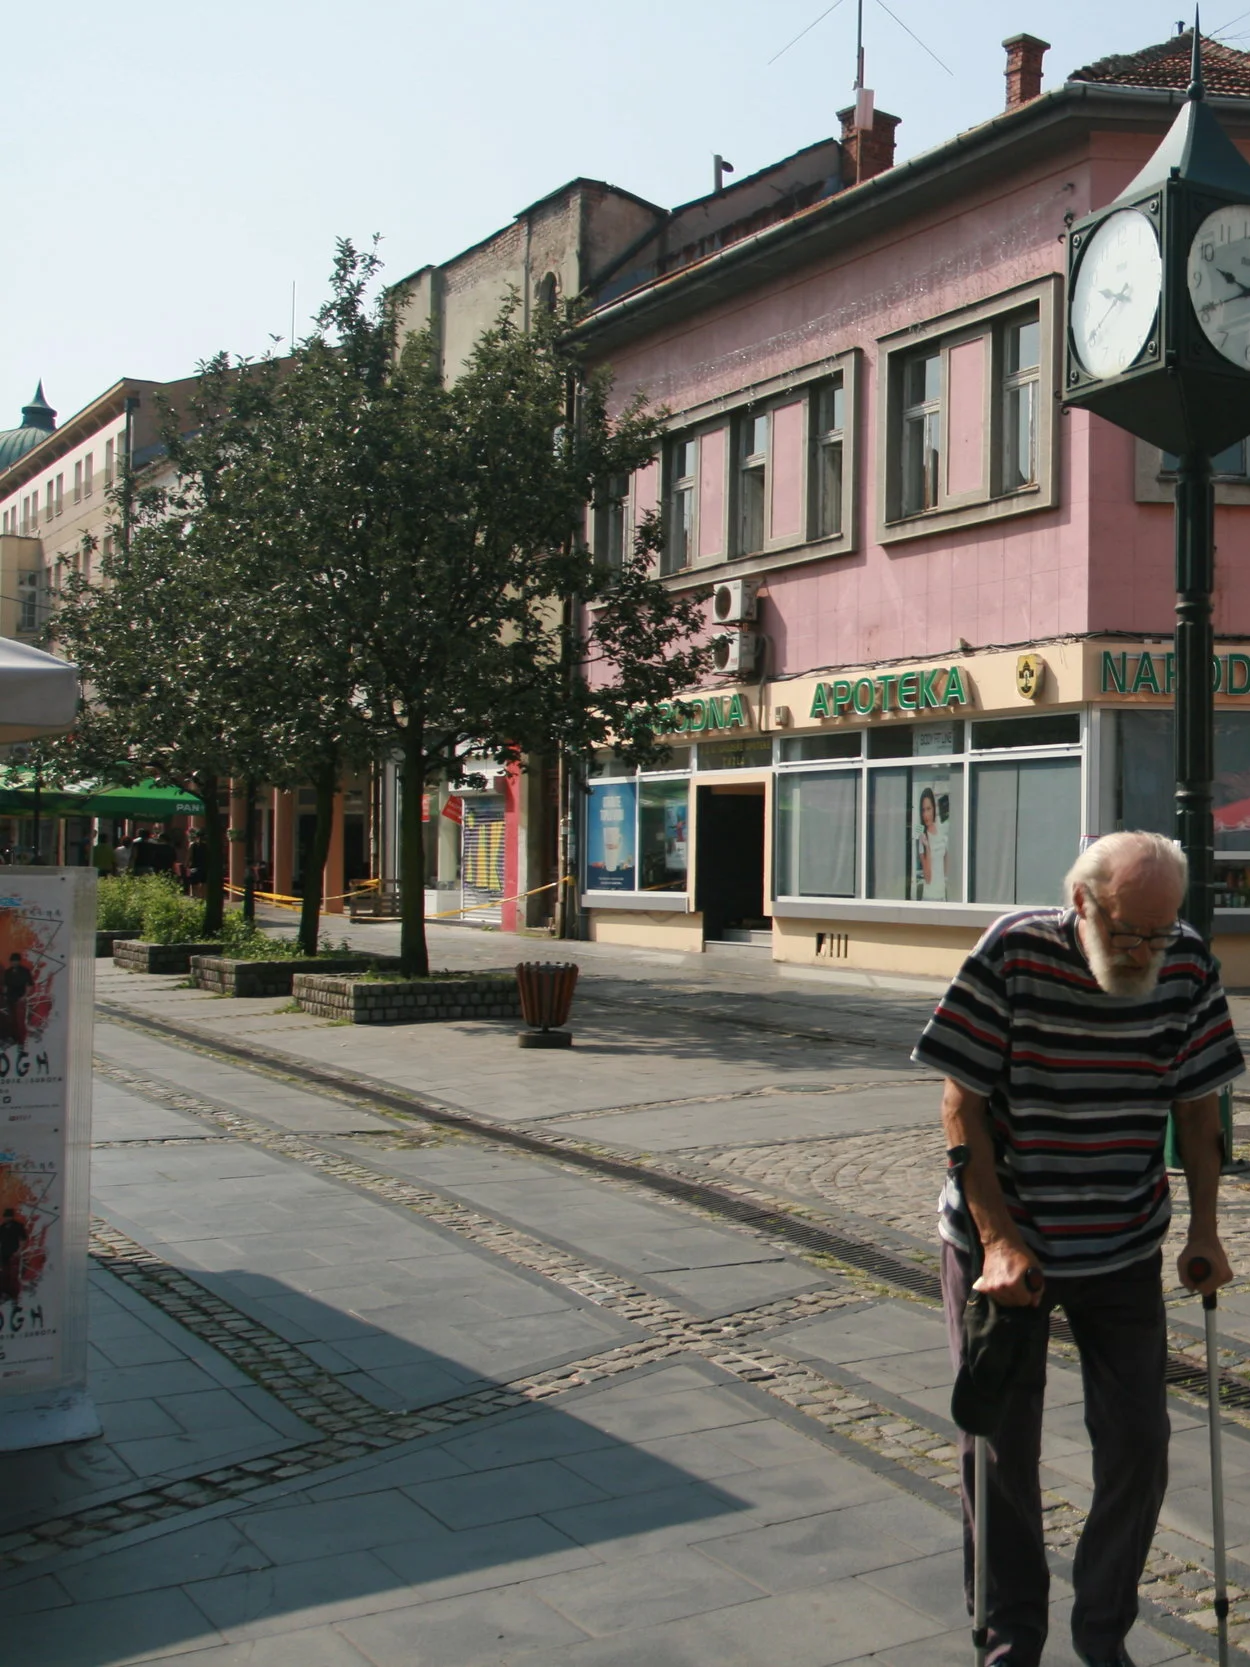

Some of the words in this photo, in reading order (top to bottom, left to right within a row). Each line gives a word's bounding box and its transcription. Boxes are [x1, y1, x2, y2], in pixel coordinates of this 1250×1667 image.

[1220, 223, 1231, 245] 11
[1200, 242, 1214, 263] 10
[809, 666, 967, 719] APOTEKA
